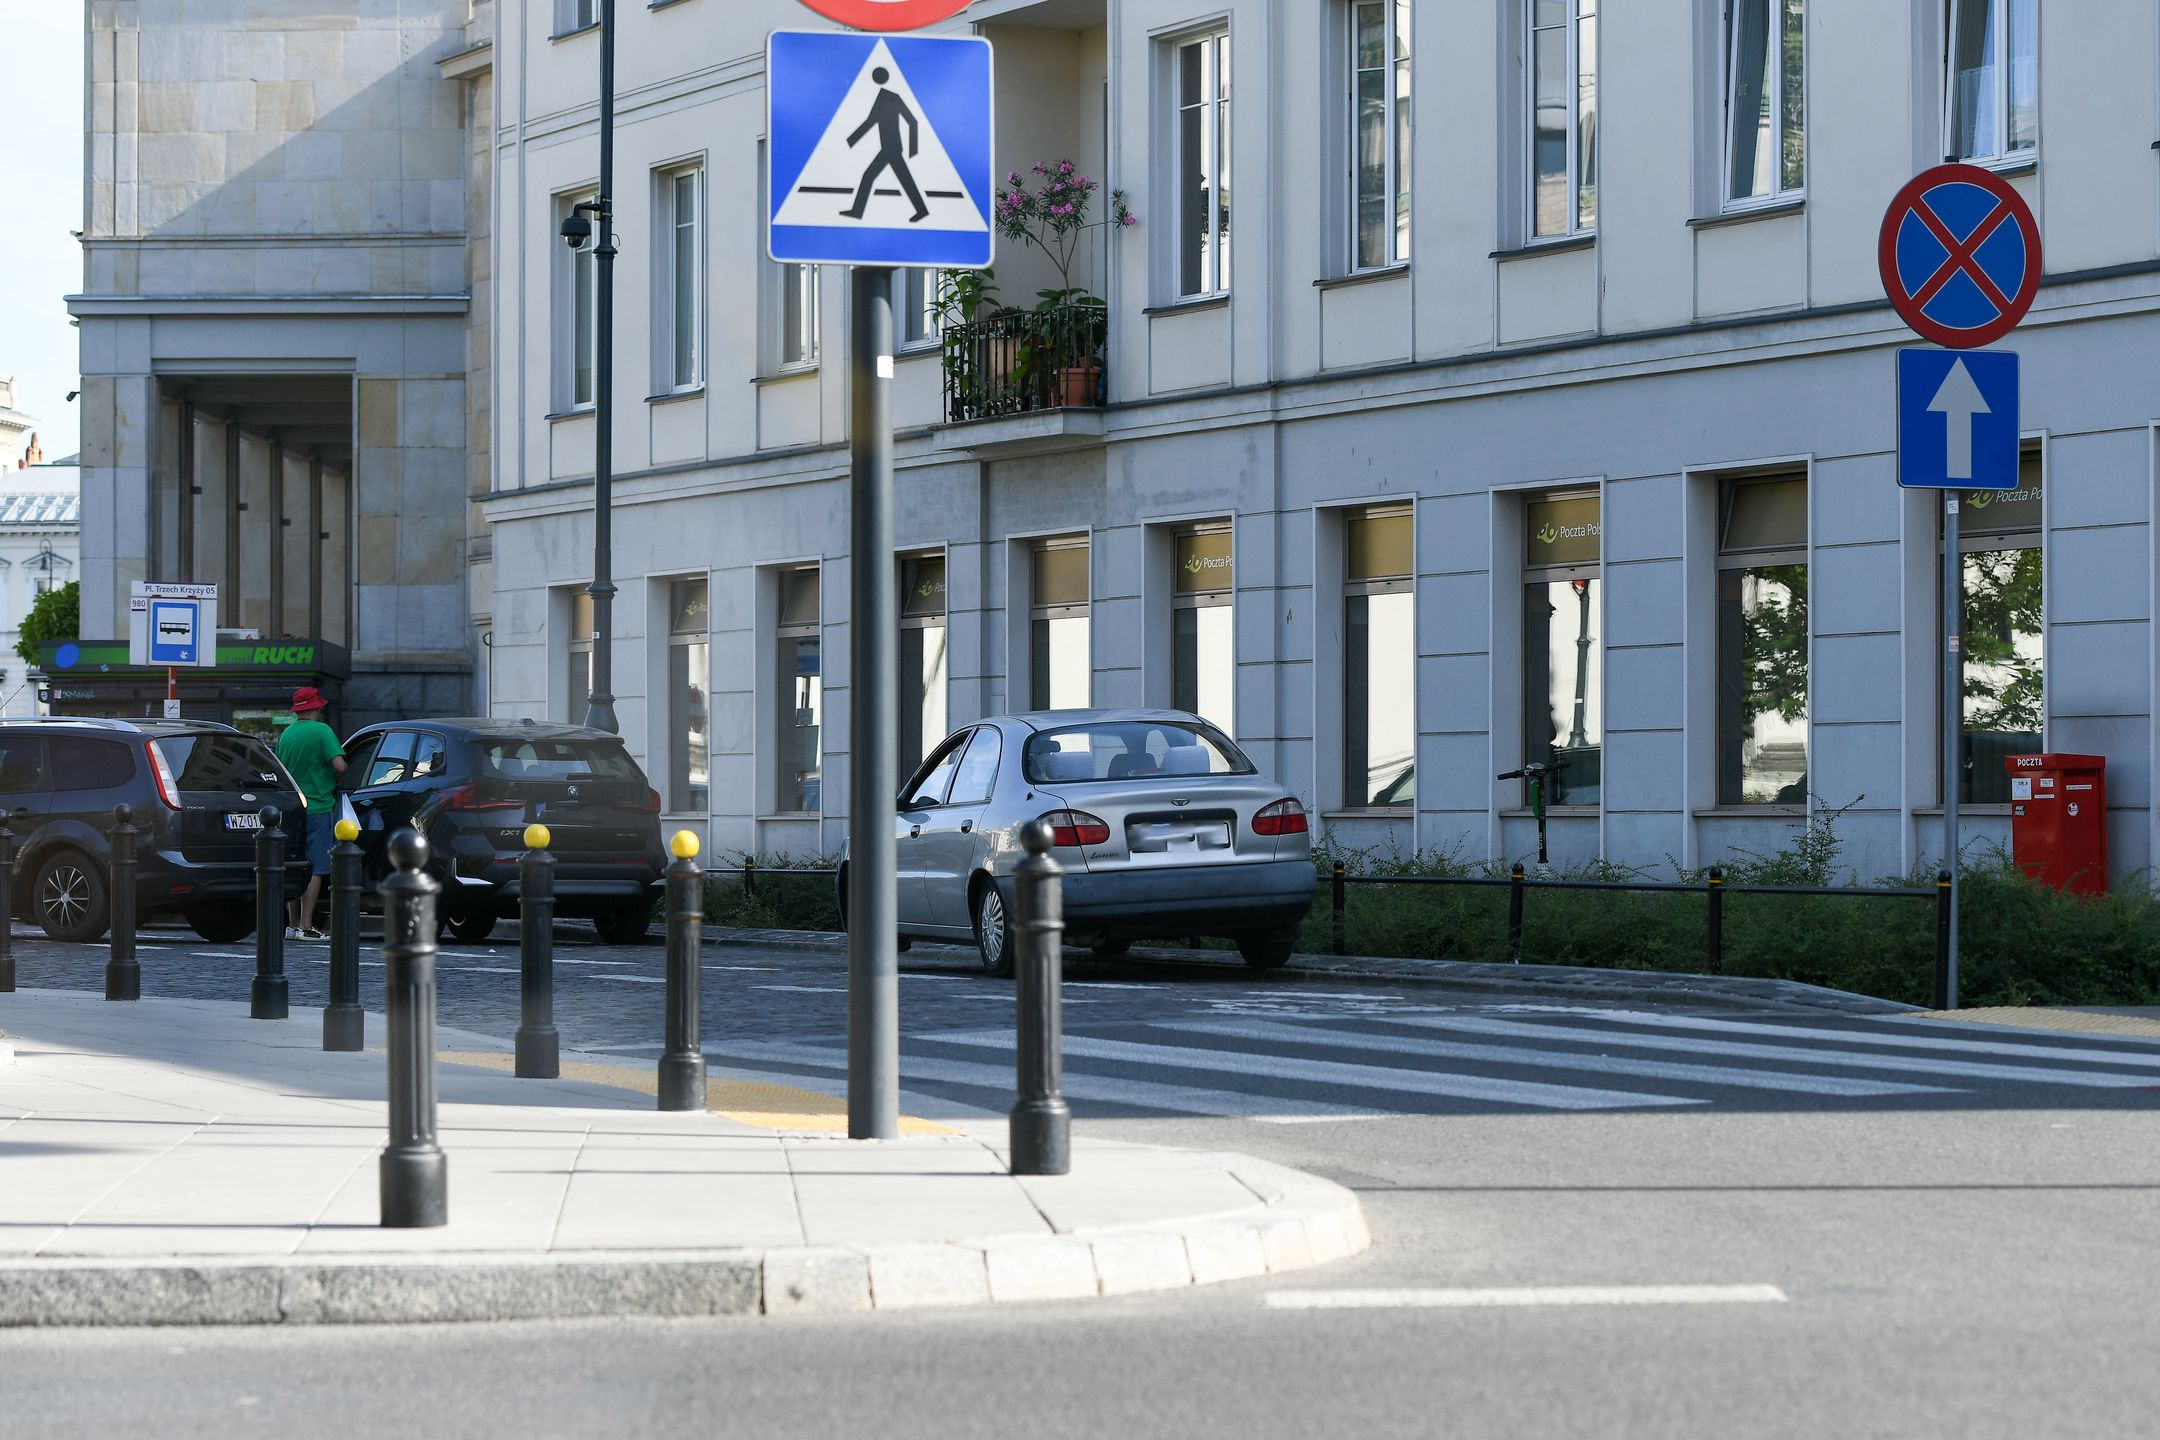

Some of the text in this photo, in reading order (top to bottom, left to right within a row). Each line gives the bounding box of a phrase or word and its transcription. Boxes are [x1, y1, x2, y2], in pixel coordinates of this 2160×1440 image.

[1996, 489, 2029, 503] Poczta
[1560, 525, 1586, 538] Poczta
[1203, 557, 1225, 569] Poczta
[156, 585, 179, 593] Trzech
[180, 586, 204, 596] Krzyży
[205, 587, 216, 595] 05
[132, 600, 146, 608] 980
[253, 646, 315, 665] RUCH
[2017, 758, 2043, 767] POCZTA
[230, 815, 245, 828] WZ
